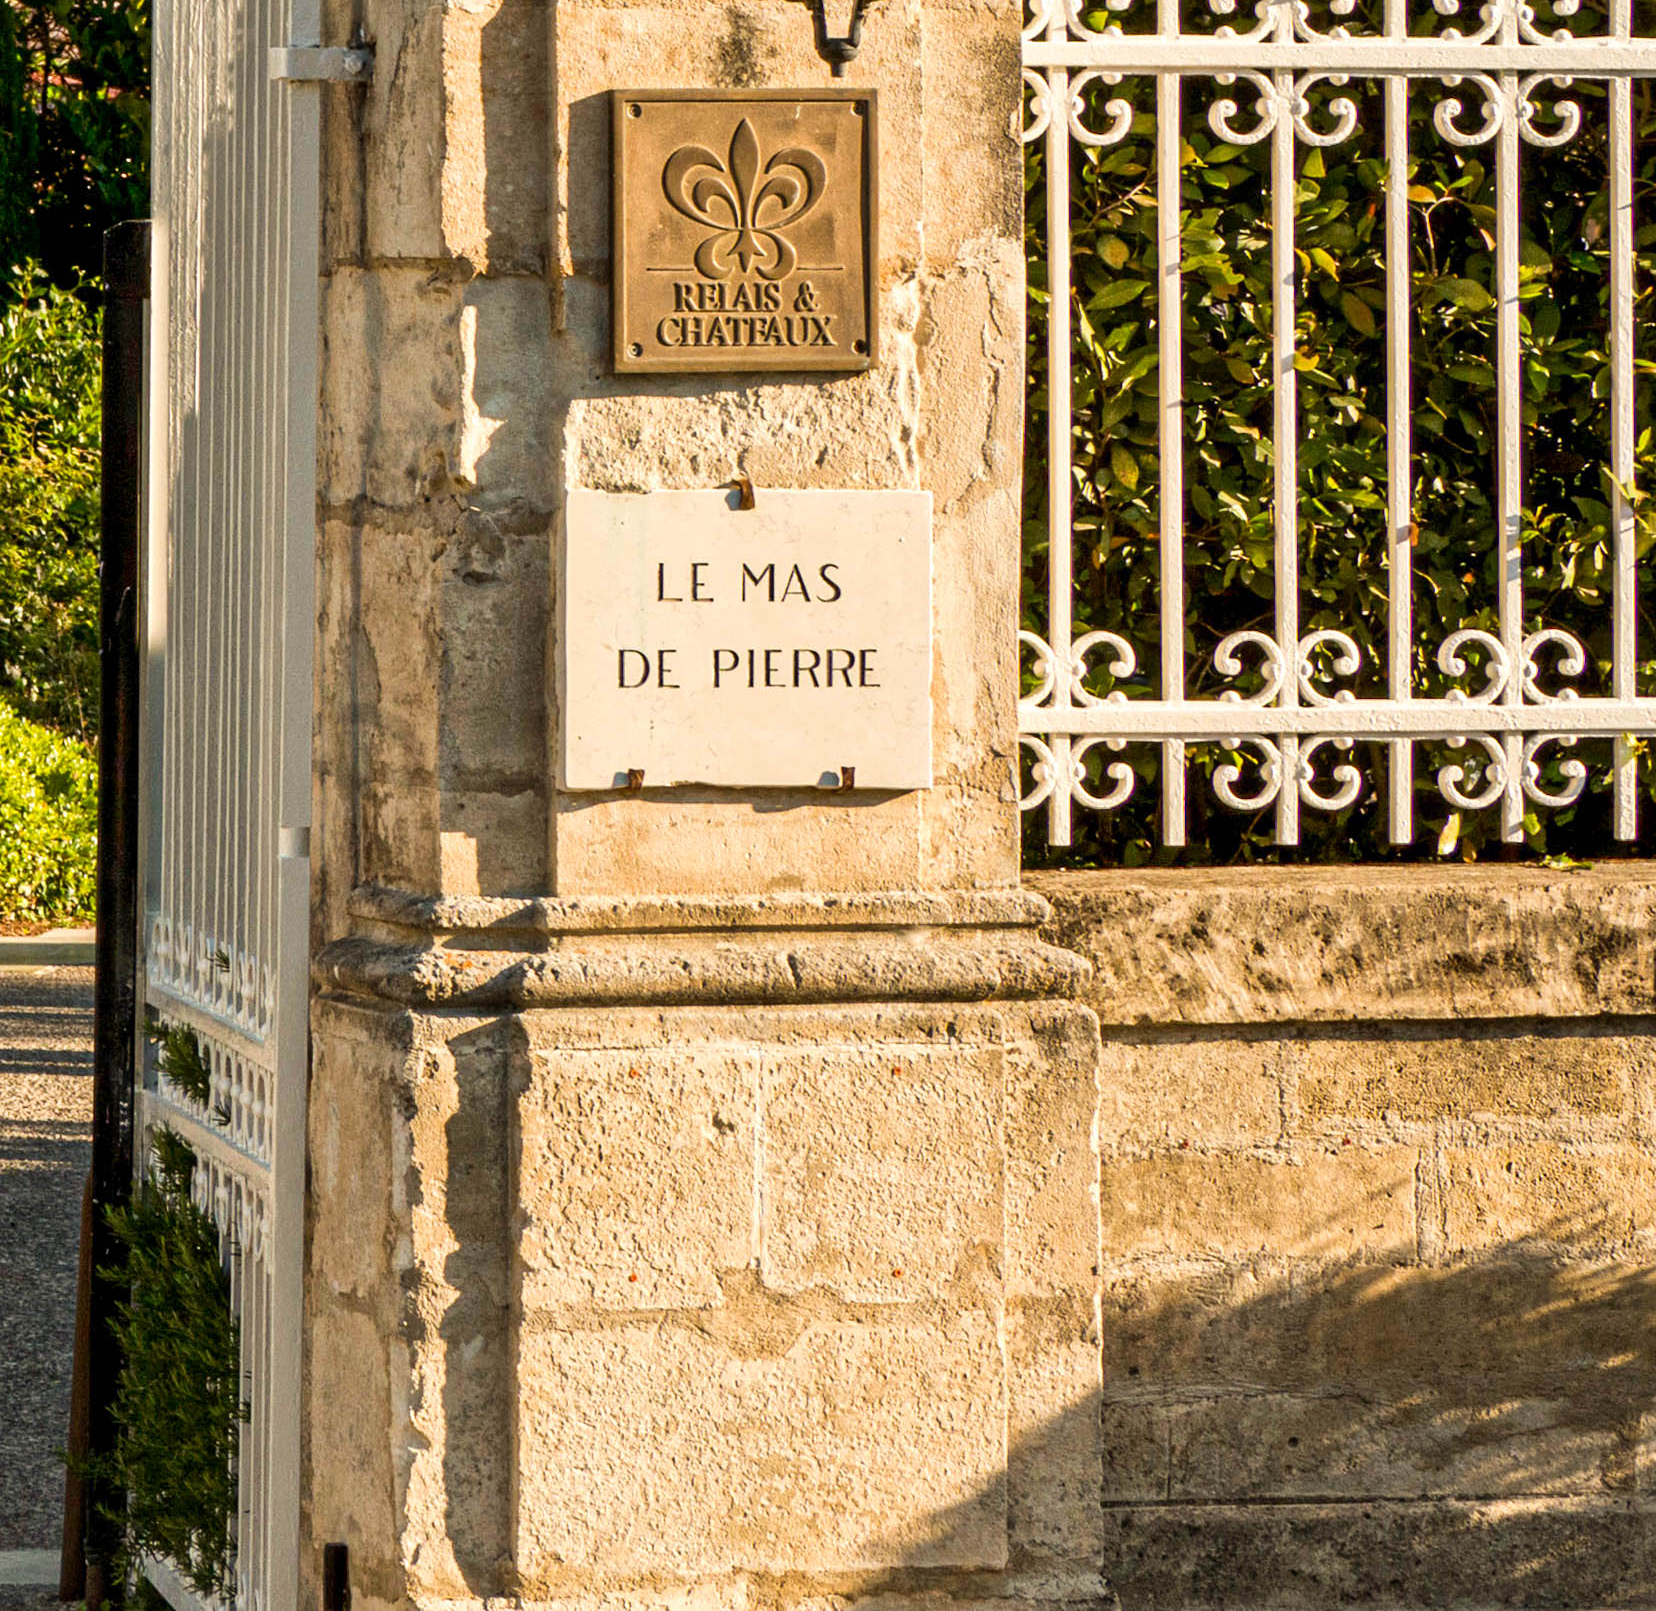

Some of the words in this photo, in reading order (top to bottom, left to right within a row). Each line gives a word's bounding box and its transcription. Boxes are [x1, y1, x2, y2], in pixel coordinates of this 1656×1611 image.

[672, 282, 782, 313] RELAIS
[793, 280, 821, 313] &
[656, 316, 838, 347] CHATEAUX
[657, 563, 714, 602] LE
[742, 563, 842, 602] MAS
[618, 649, 680, 688] DE
[713, 649, 880, 688] PIERRE
